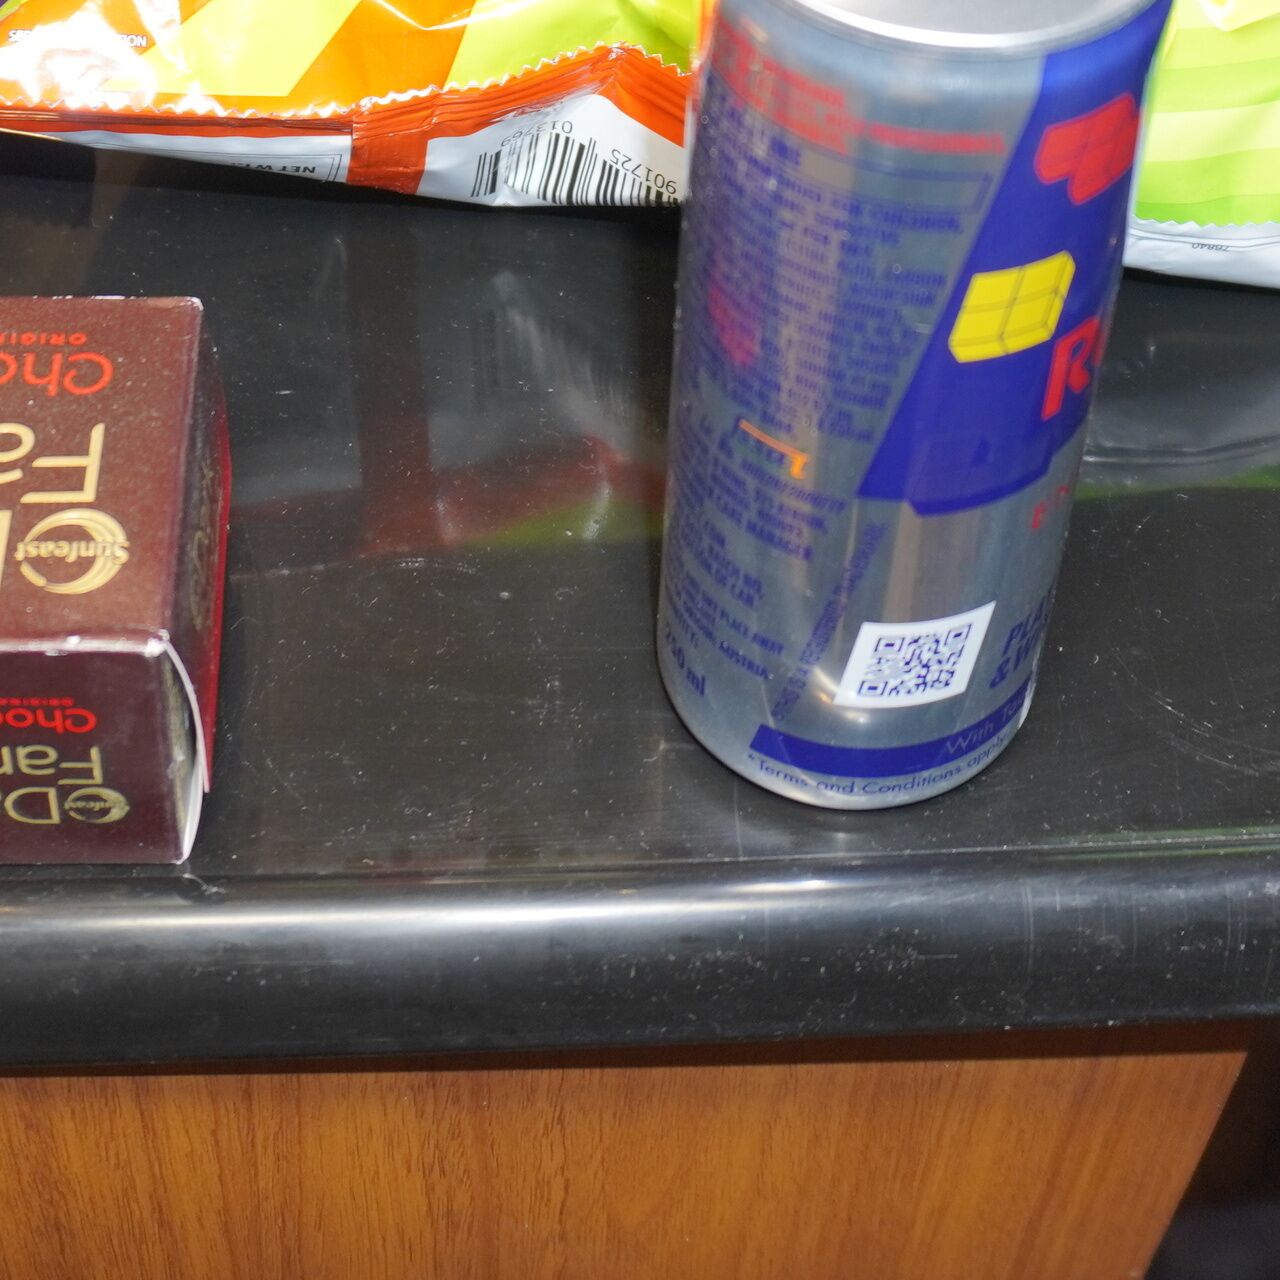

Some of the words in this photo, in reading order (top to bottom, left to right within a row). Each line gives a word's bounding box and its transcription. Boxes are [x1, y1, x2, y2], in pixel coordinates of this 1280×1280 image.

[610, 148, 677, 194] 901725
[14, 540, 130, 565] Sunfeast
[816, 778, 855, 794] and
[861, 764, 962, 794] Conditions
